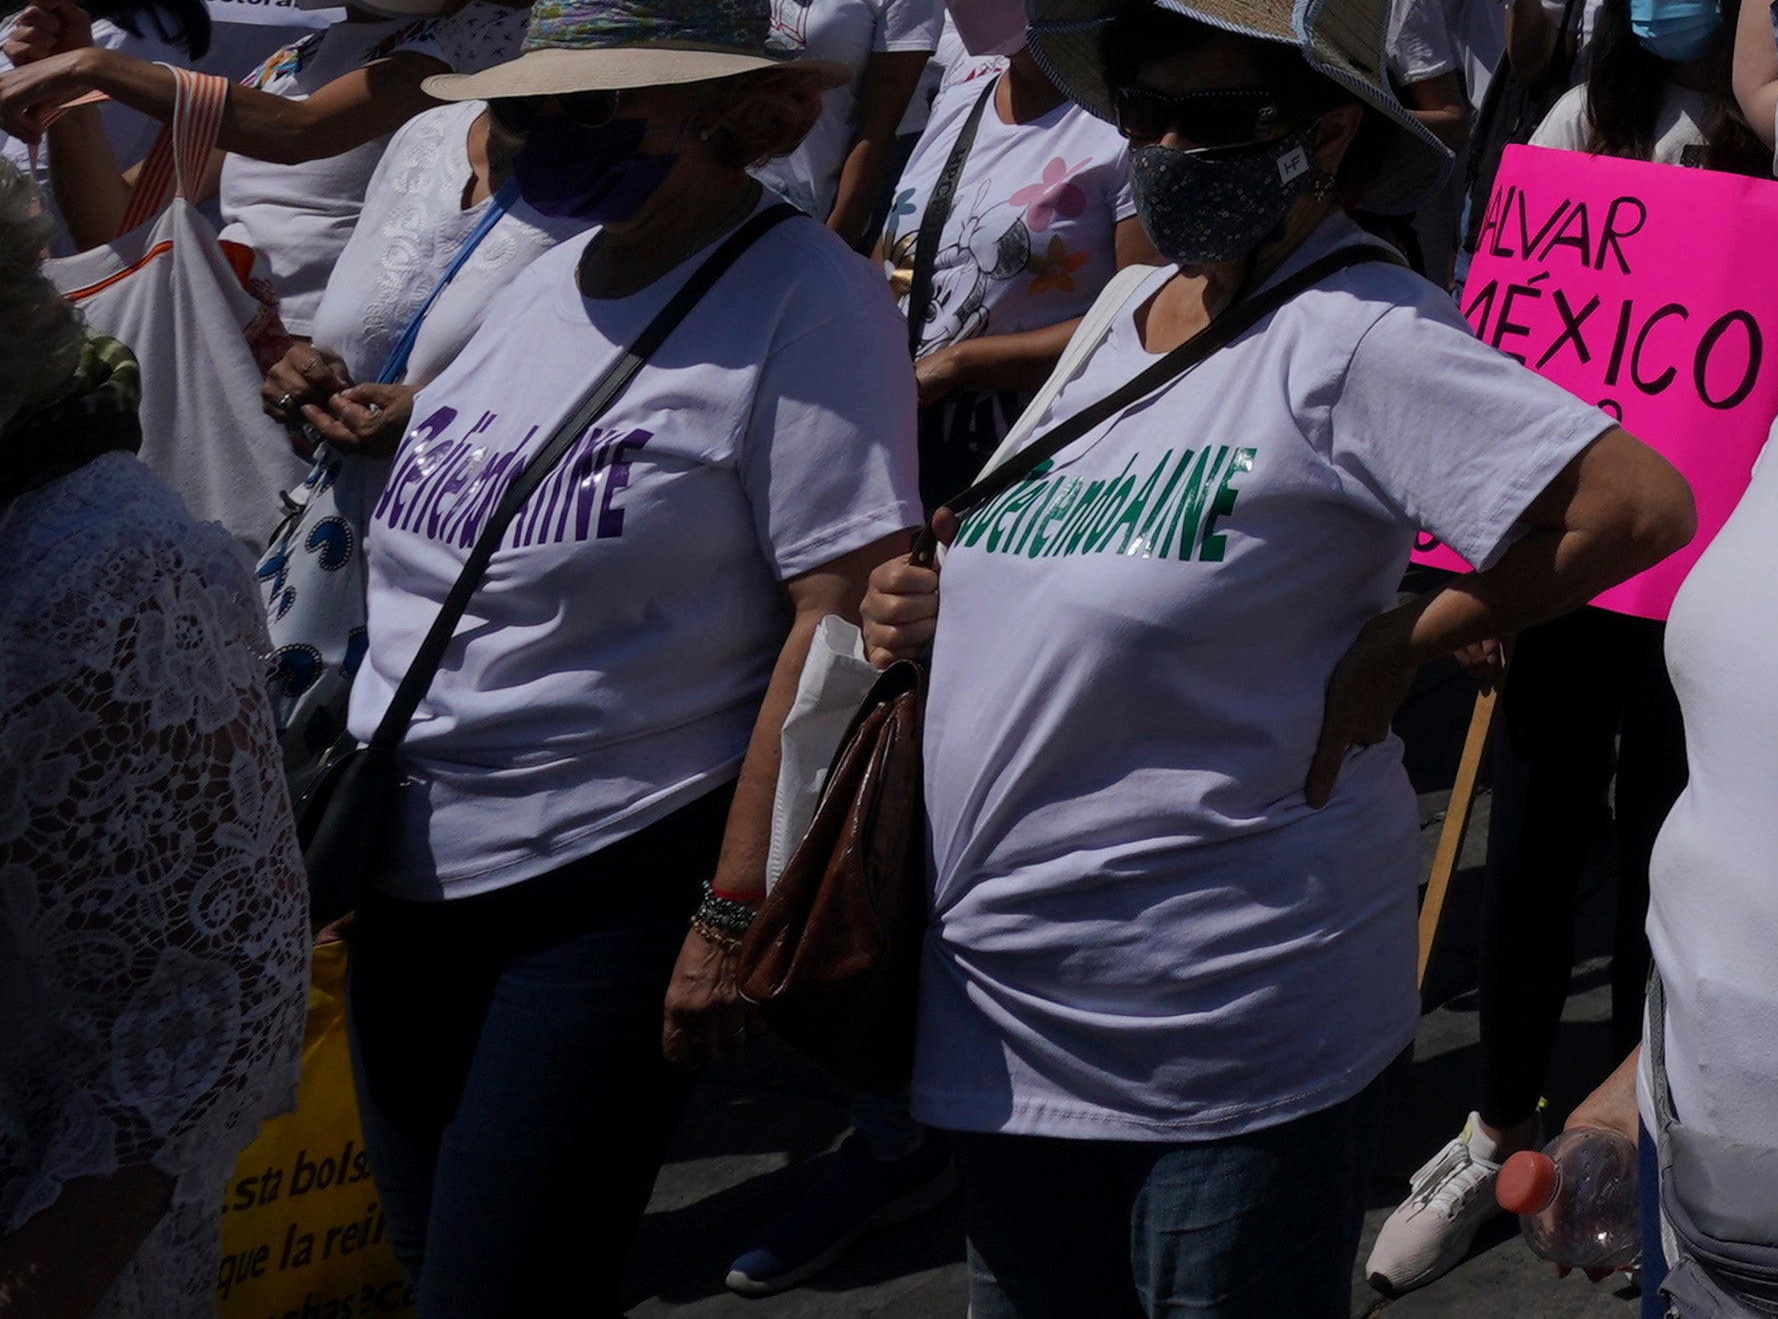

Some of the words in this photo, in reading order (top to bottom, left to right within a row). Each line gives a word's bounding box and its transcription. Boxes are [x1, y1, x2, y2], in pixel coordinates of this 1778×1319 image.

[1475, 185, 1648, 275] ALVAR
[222, 1167, 283, 1213] sta
[289, 1140, 371, 1196] bols
[279, 1223, 315, 1271] la
